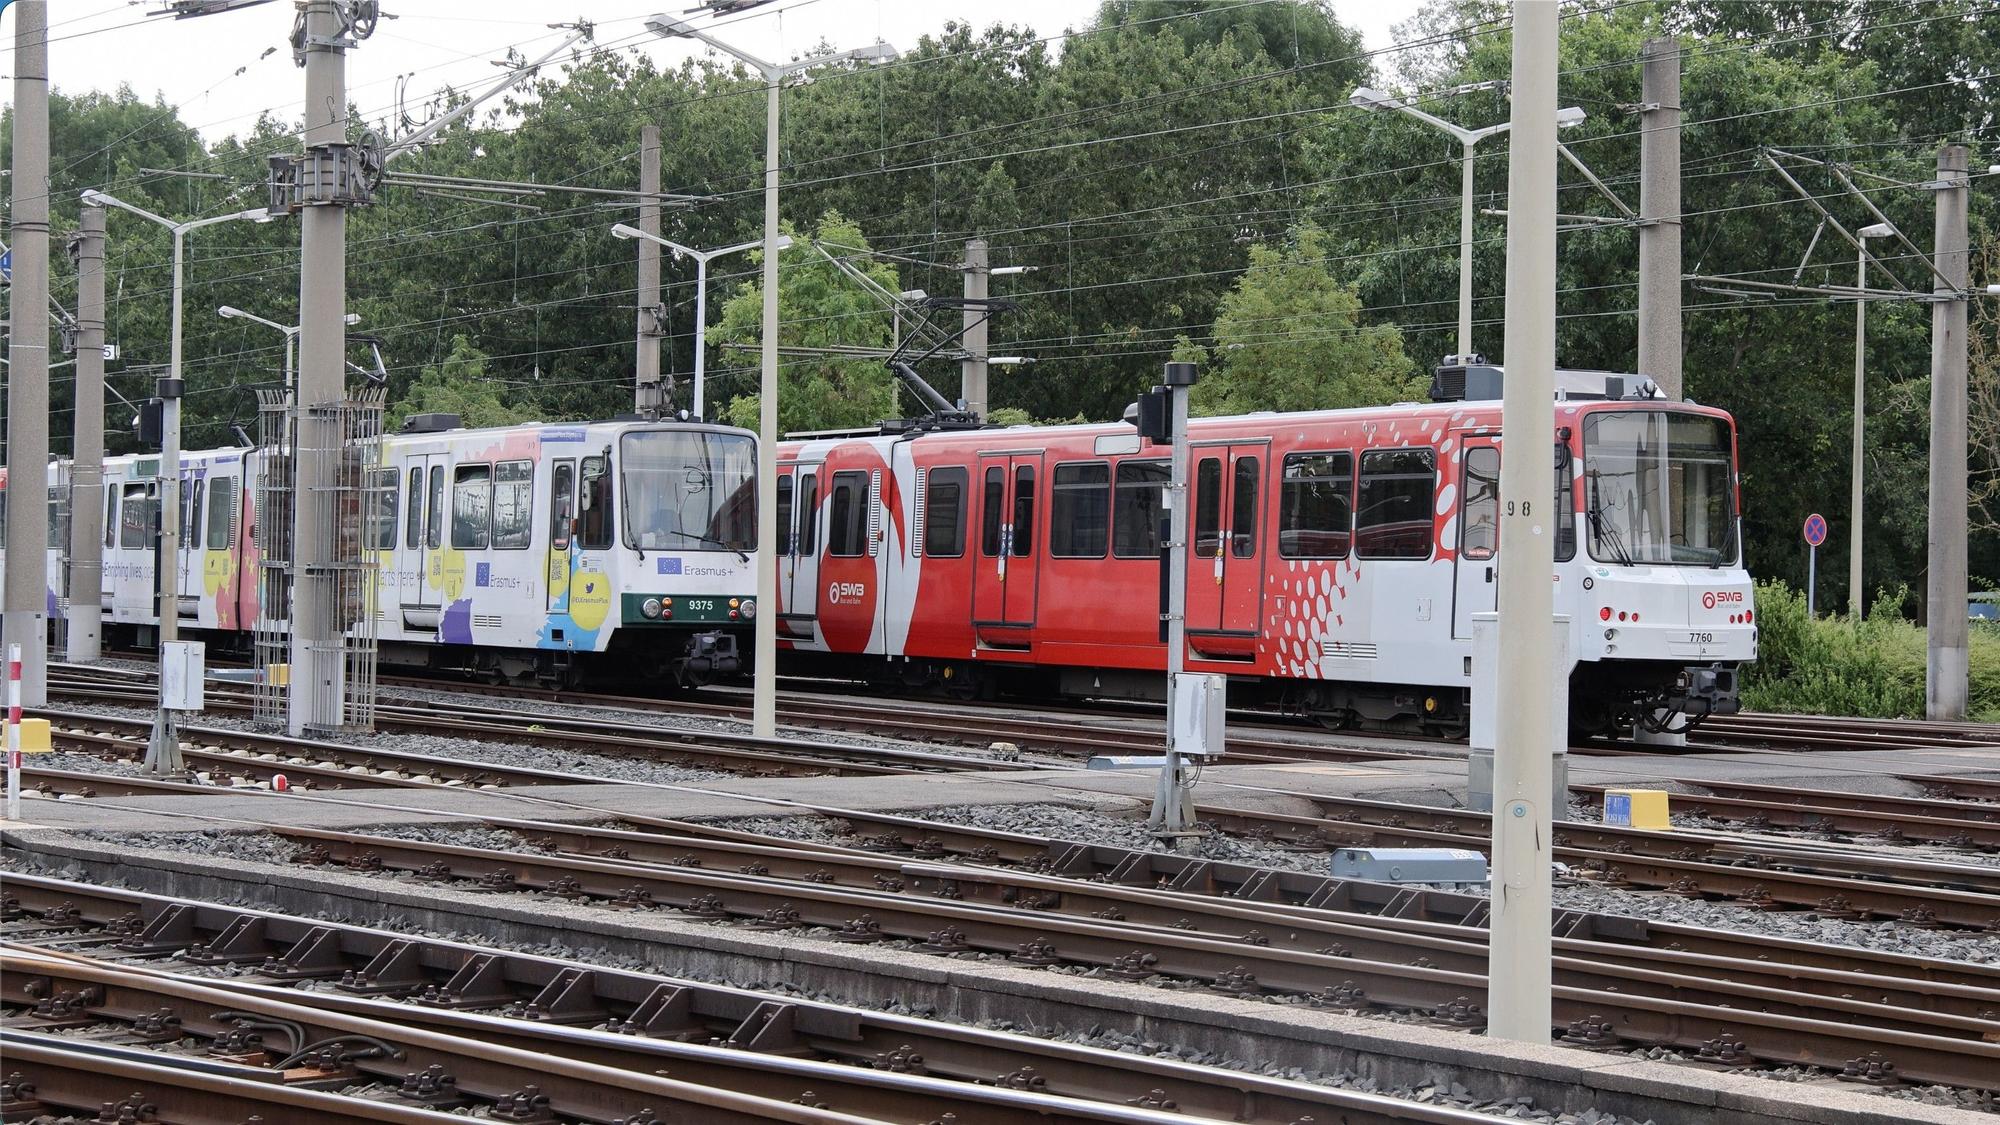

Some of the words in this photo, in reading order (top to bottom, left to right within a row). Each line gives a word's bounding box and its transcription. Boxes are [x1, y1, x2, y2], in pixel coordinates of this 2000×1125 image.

[104, 562, 128, 581] Enriching
[684, 566, 734, 577] Erasmus+
[490, 574, 521, 588] Erasmus+
[840, 583, 864, 596] SWB
[1717, 592, 1742, 602] SWB
[689, 600, 713, 610] 9375
[1689, 633, 1713, 643] 7760
